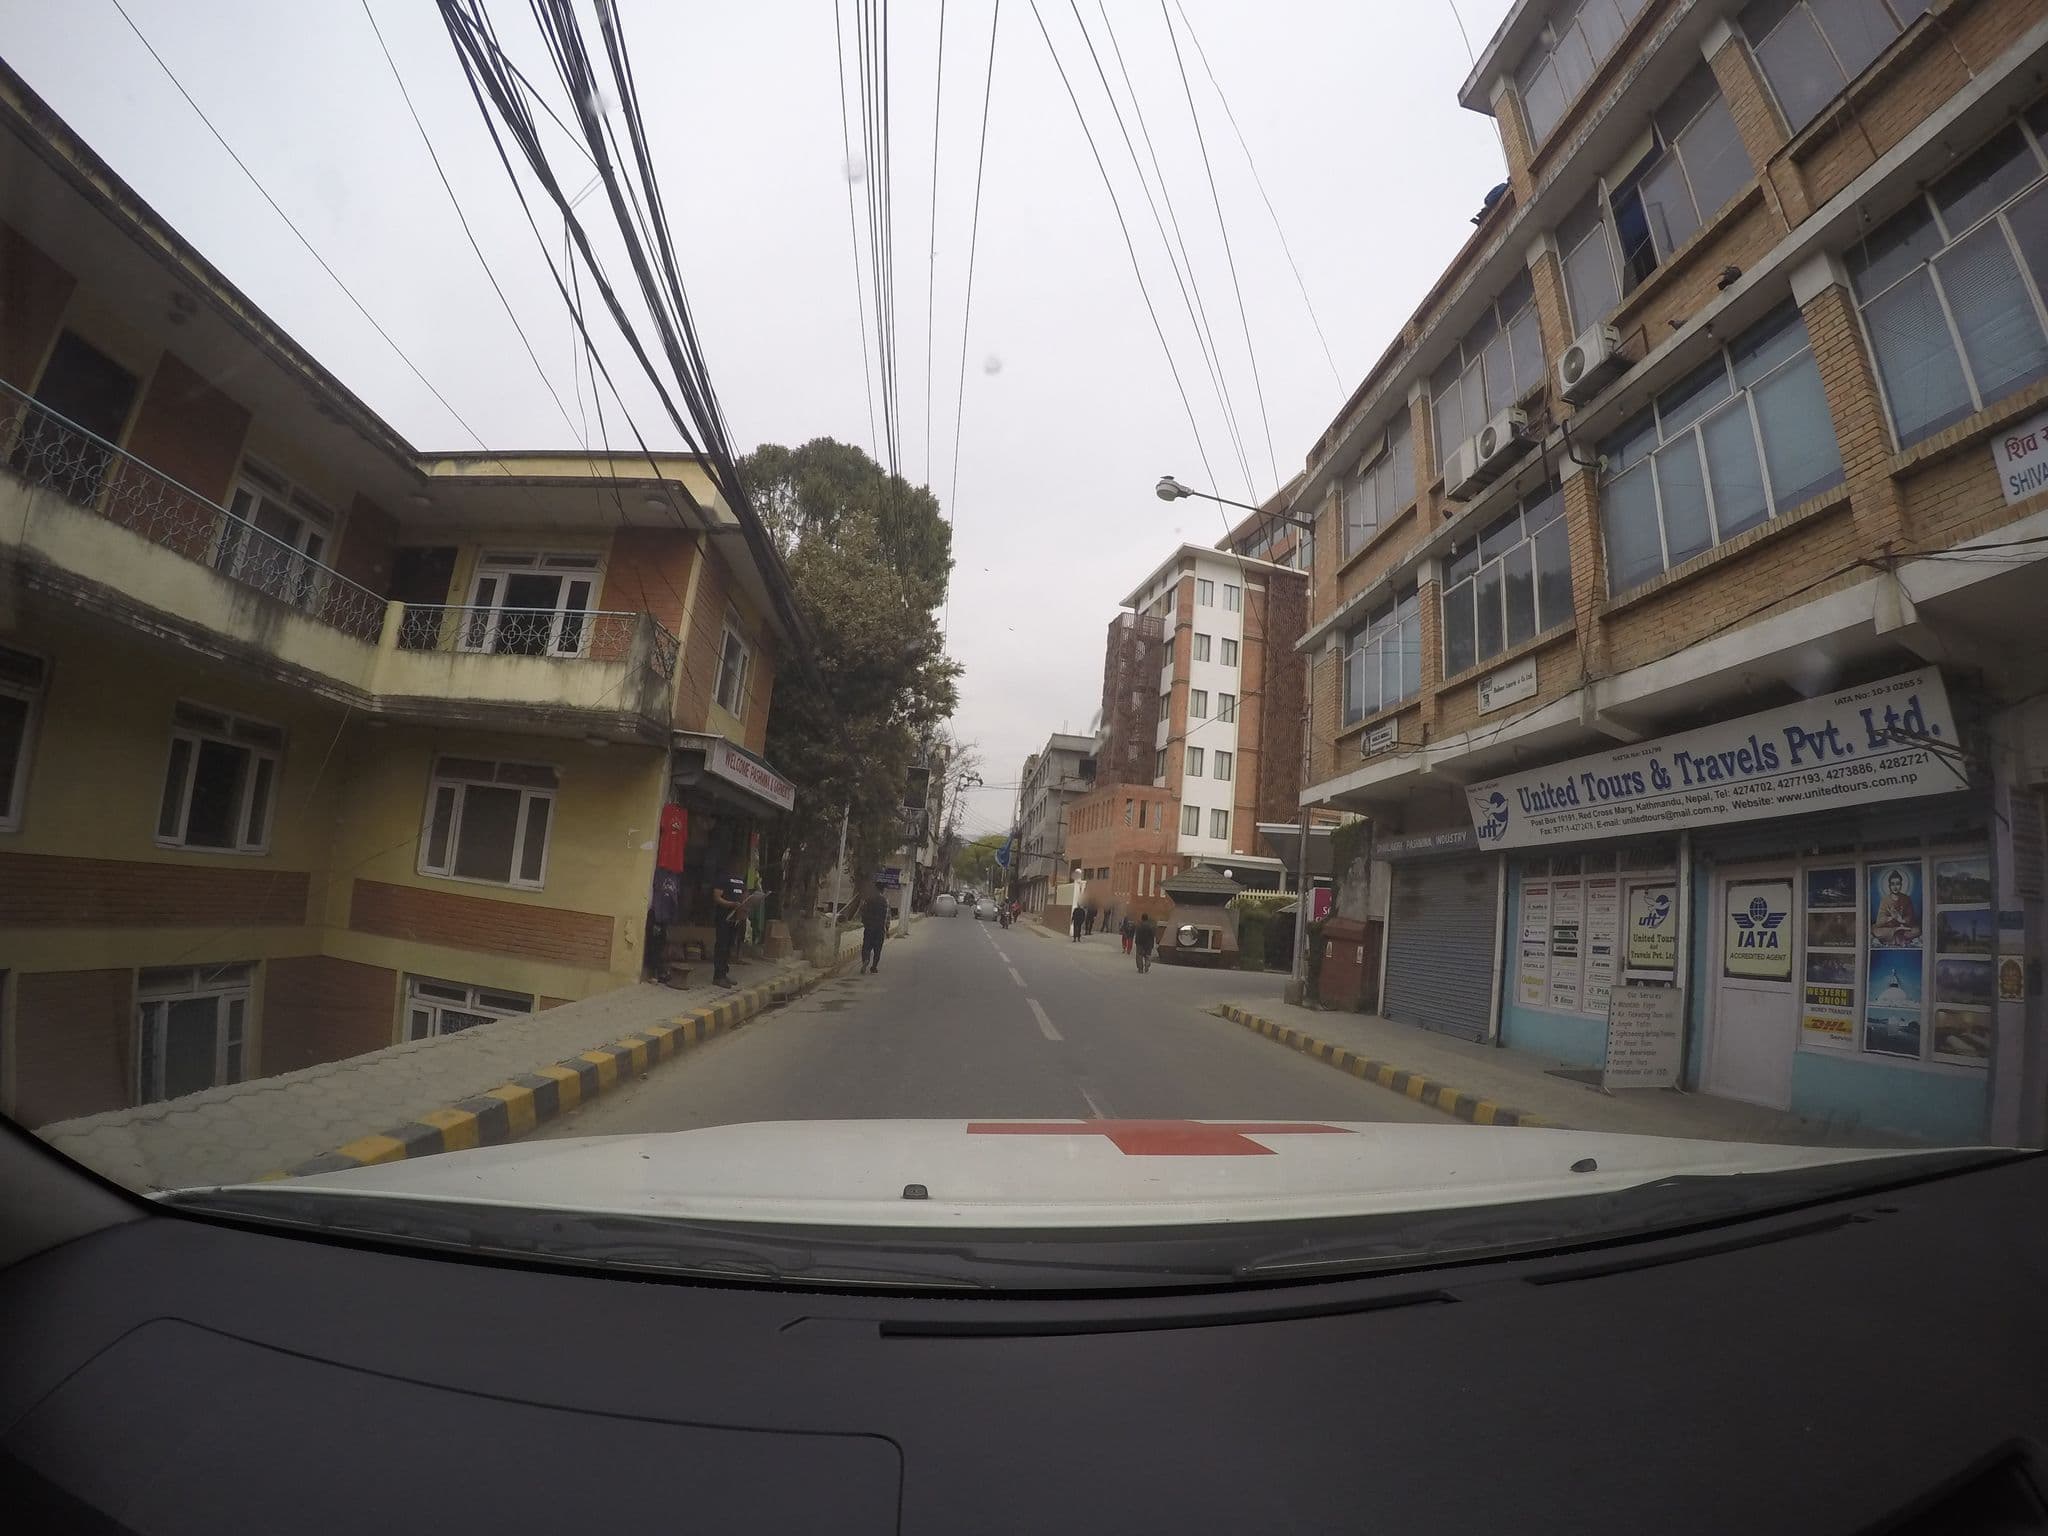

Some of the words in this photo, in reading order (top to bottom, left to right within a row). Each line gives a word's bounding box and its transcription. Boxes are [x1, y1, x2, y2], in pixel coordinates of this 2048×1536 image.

[2005, 433, 2038, 461] शिव
[1834, 694, 1853, 705] IATA
[1854, 691, 1871, 701] No:
[1893, 680, 1915, 692] 0265
[1917, 677, 1923, 686] 5
[1517, 775, 1580, 813] United
[1581, 771, 1645, 802] Tours
[1650, 758, 1671, 790] &
[1674, 735, 1779, 785] Travels
[1783, 720, 1853, 765] Pvt.
[1859, 695, 1940, 749] Ltd.
[1531, 818, 1543, 827] Post
[1544, 816, 1557, 825] Box
[1578, 811, 1592, 820] Red
[1592, 808, 1614, 818] Cross
[1614, 805, 1635, 815] Marg,
[1636, 798, 1683, 812] Kathmandu,
[1685, 791, 1713, 804] Nepal,
[1714, 789, 1730, 800] Tel:
[1732, 781, 1776, 796] 4274702,
[1777, 773, 1824, 789] 4277193,
[1826, 763, 1877, 780] 4273886,
[1879, 752, 1929, 771] 4282721
[1597, 818, 1620, 829] E-mail:
[1622, 805, 1729, 825] unitedtours@mail.com.np,
[1732, 797, 1775, 810] Website:
[1776, 773, 1918, 803] www.unitedtours.com.np
[1633, 934, 1655, 943] United
[1737, 931, 1778, 949] IATA
[1631, 951, 1651, 960] Travels
[1729, 952, 1766, 960] ACCREDITED
[1766, 953, 1787, 961] AGENT
[1807, 987, 1847, 998] WESTERN
[1818, 996, 1847, 1006] UNION
[1811, 1019, 1847, 1031] DHL
